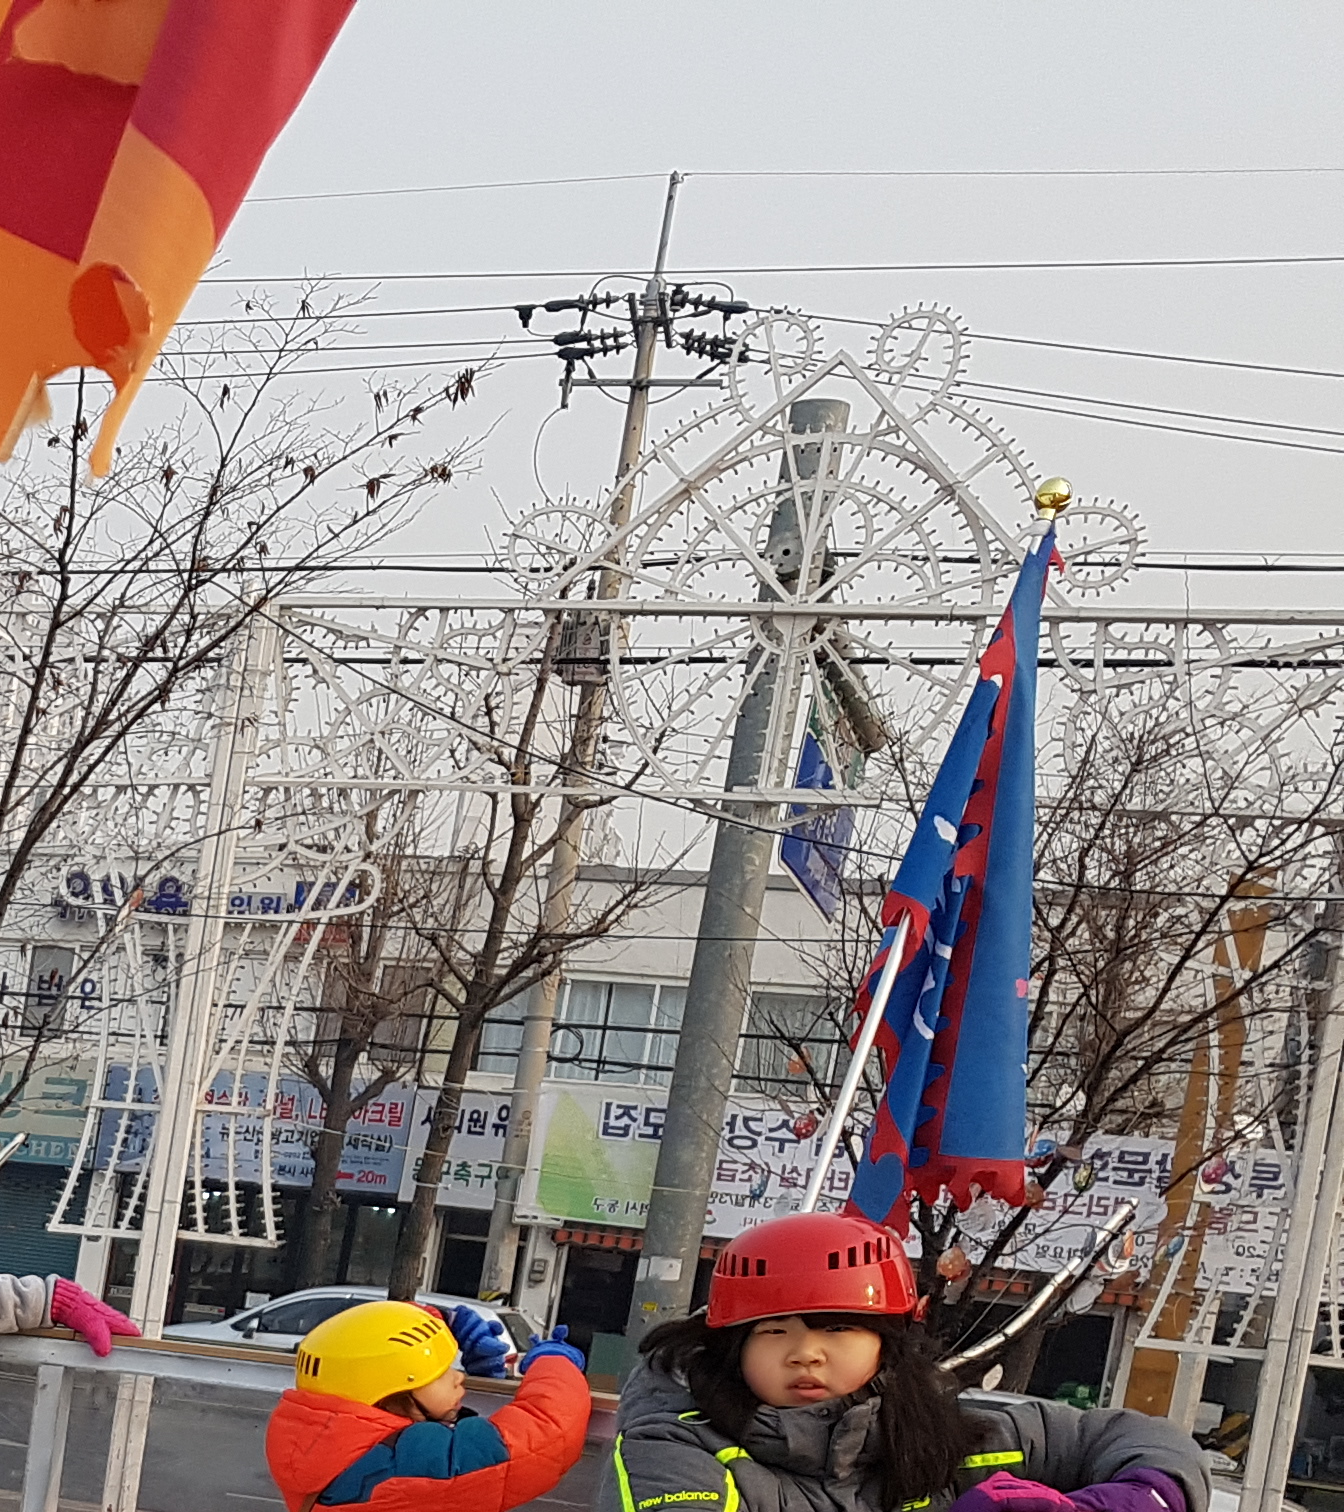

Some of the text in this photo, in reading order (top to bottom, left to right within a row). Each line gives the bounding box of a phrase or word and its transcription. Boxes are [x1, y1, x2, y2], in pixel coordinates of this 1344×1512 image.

[356, 1170, 387, 1185] 20m
[638, 1490, 719, 1510] new balance
